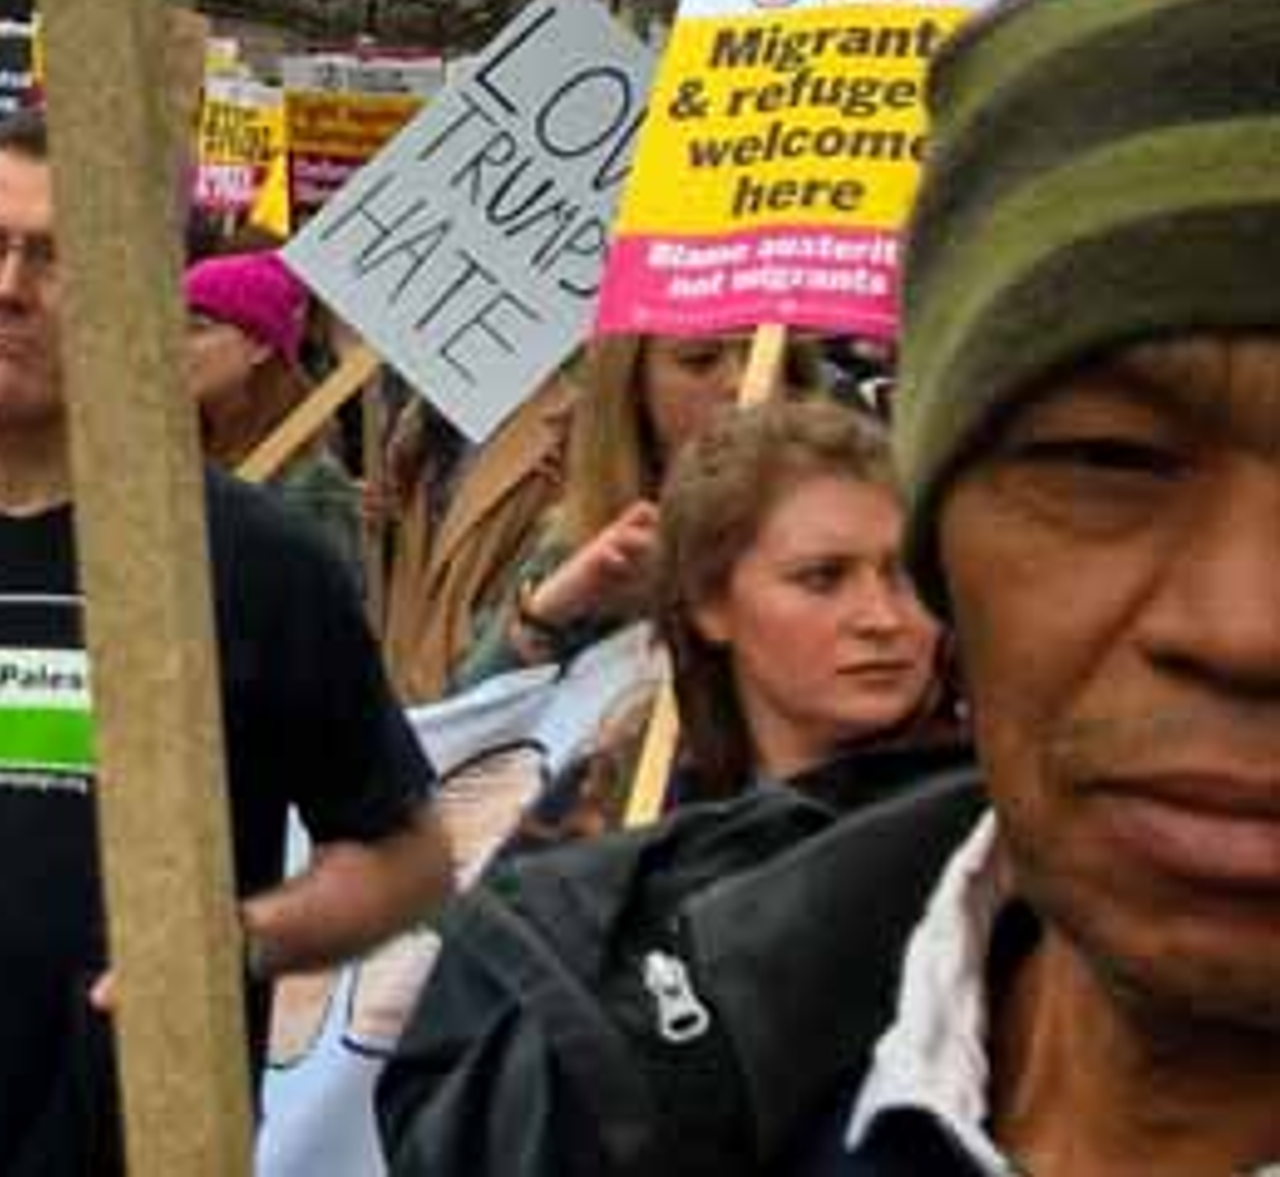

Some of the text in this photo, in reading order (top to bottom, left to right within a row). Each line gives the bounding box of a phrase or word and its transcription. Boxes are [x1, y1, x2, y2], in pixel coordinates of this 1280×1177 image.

[710, 19, 938, 72] Migrant
[476, 7, 649, 191] LOV
[668, 68, 918, 119] & refuge
[732, 175, 864, 216] here
[647, 234, 898, 269] Blame austerit
[322, 175, 542, 385] HATE
[668, 269, 888, 298] not migrants
